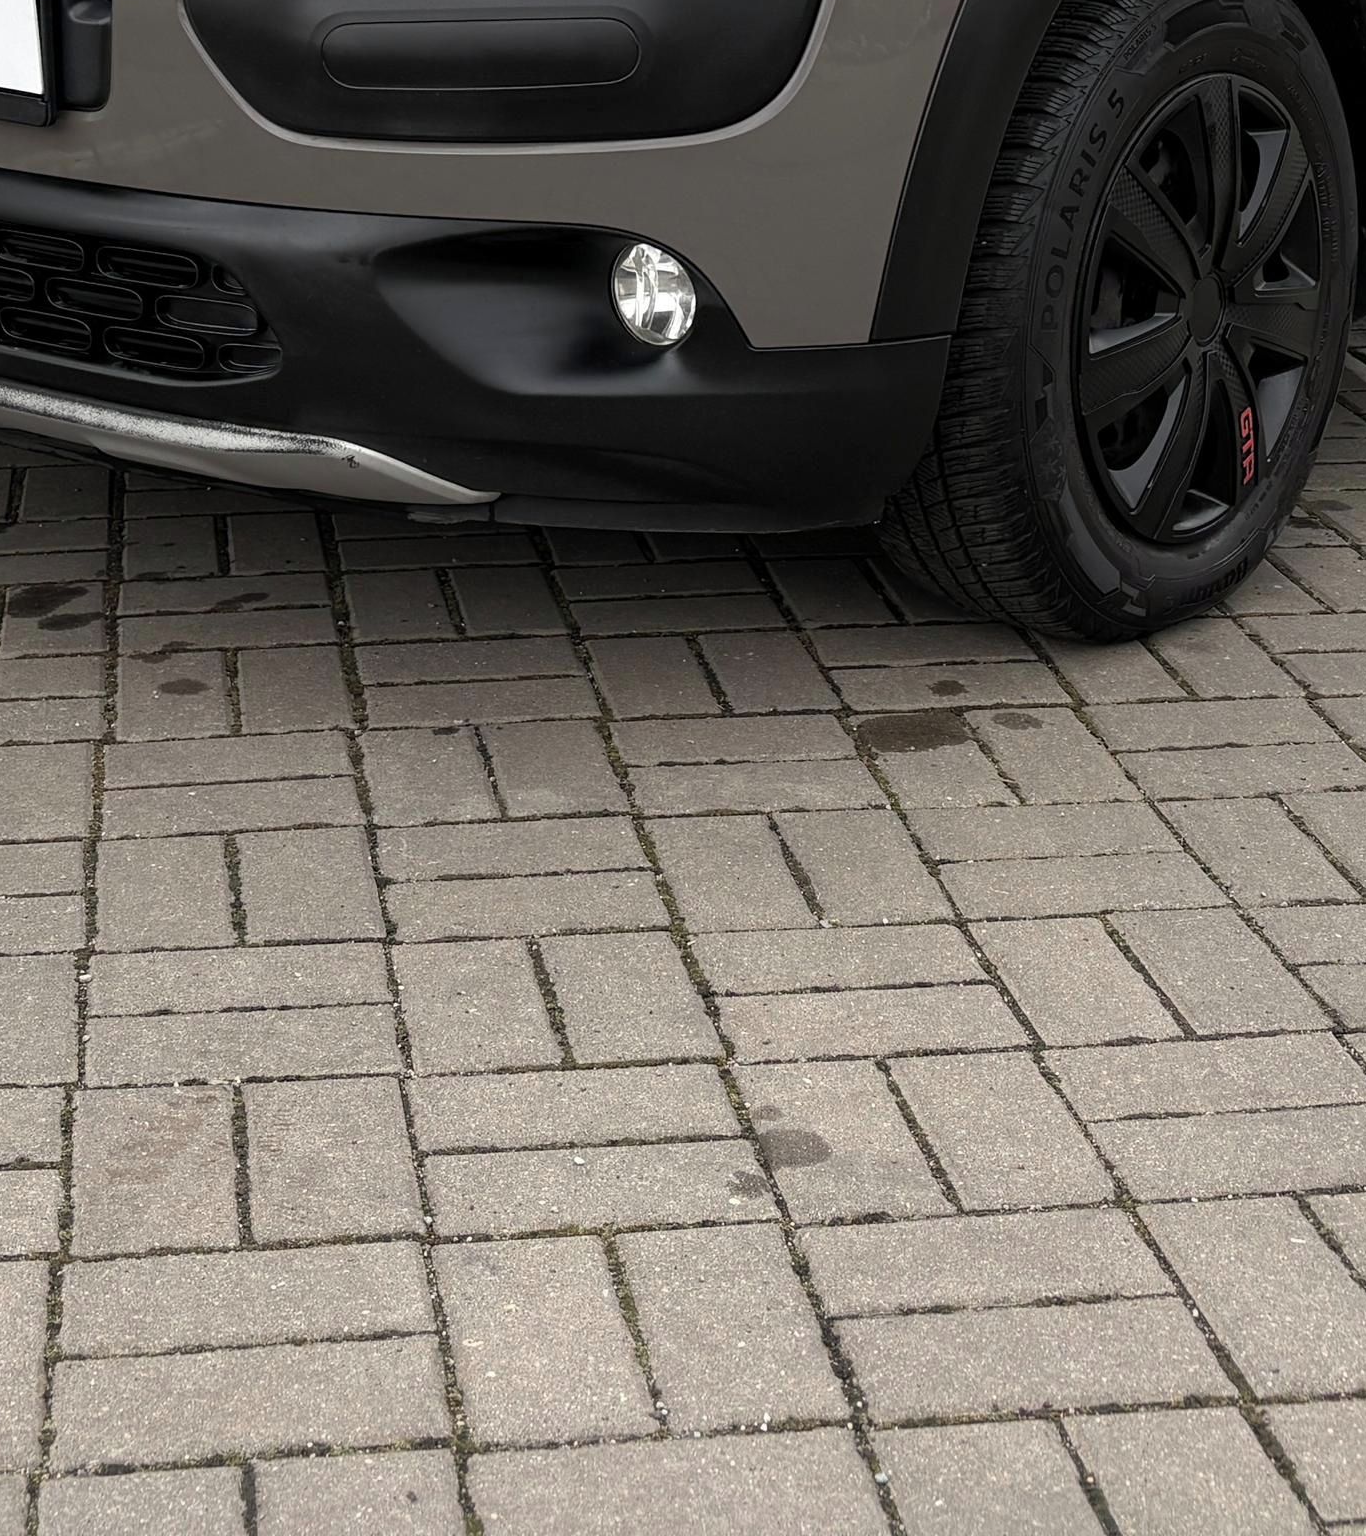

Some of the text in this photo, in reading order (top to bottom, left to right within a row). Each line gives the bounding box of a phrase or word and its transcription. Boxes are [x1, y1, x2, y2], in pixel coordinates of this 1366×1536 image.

[1041, 87, 1126, 333] POLARIS 5
[1241, 406, 1255, 486] GTA
